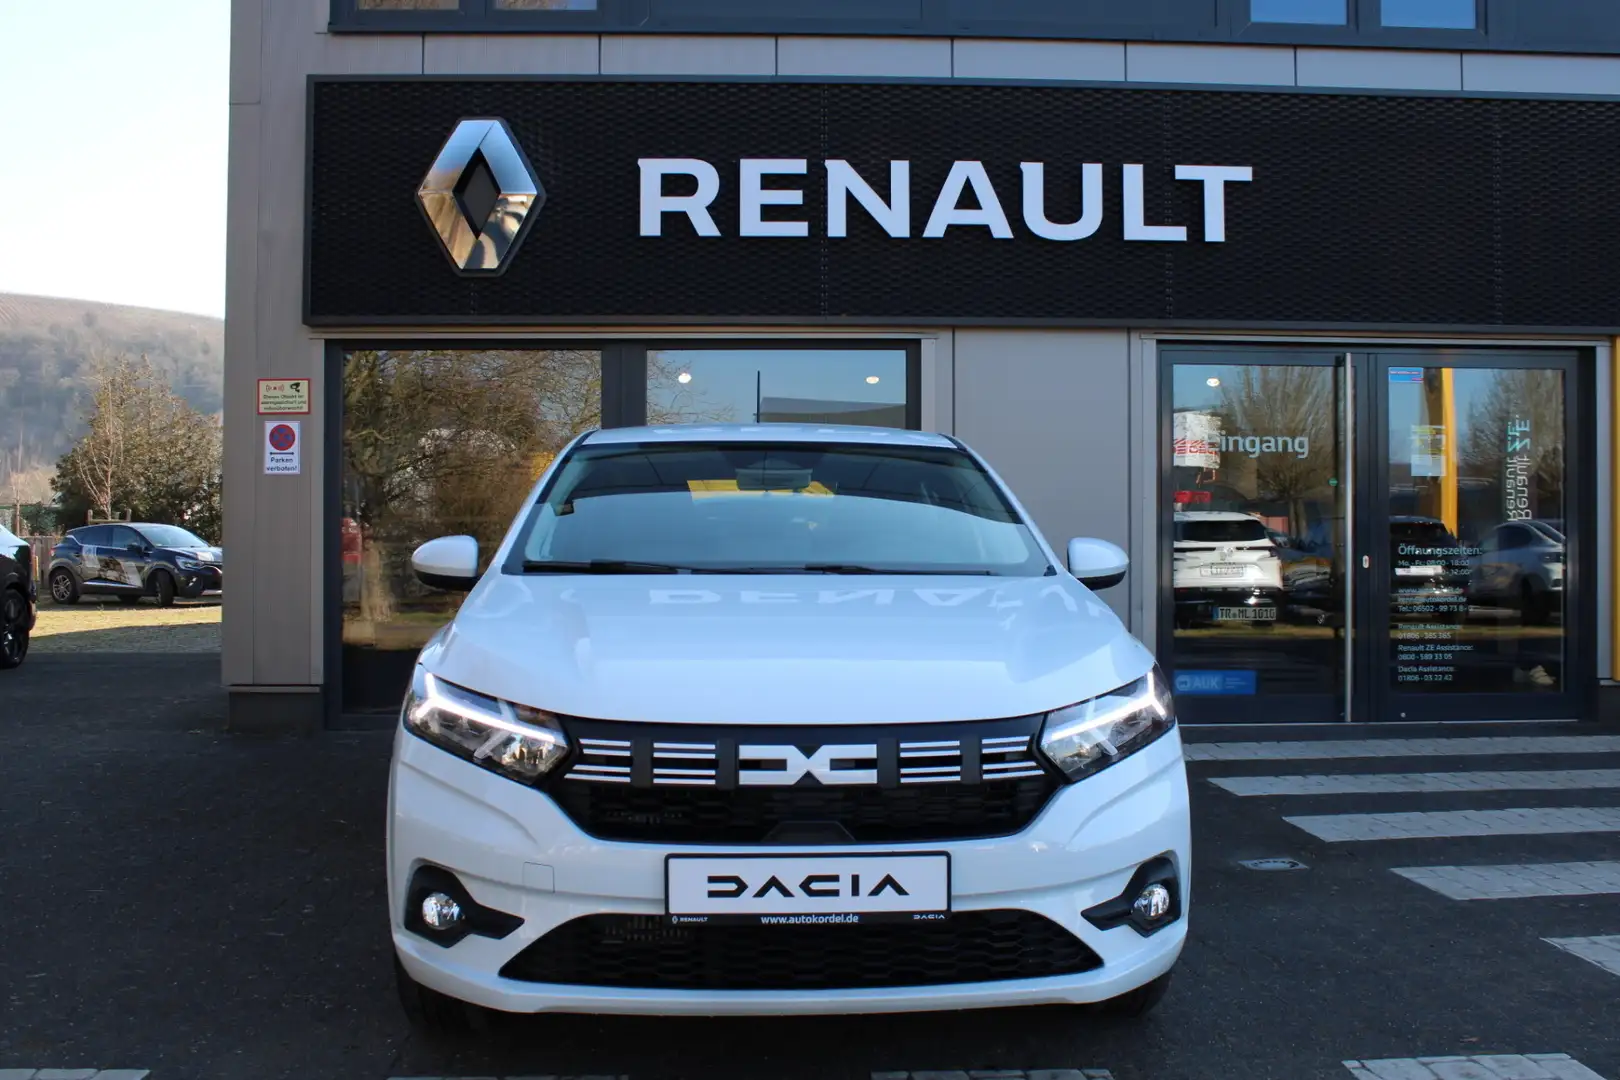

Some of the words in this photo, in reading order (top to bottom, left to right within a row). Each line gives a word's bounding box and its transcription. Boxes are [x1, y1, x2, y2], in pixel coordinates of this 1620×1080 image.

[637, 158, 1253, 243] RENAULT
[1398, 543, 1483, 557] Öffnungszeiten:
[1219, 608, 1231, 619] TR
[1238, 608, 1251, 619] ML
[1252, 608, 1276, 619] 1010
[707, 873, 910, 898] DACIA
[761, 914, 859, 924] www.autokordel.de
